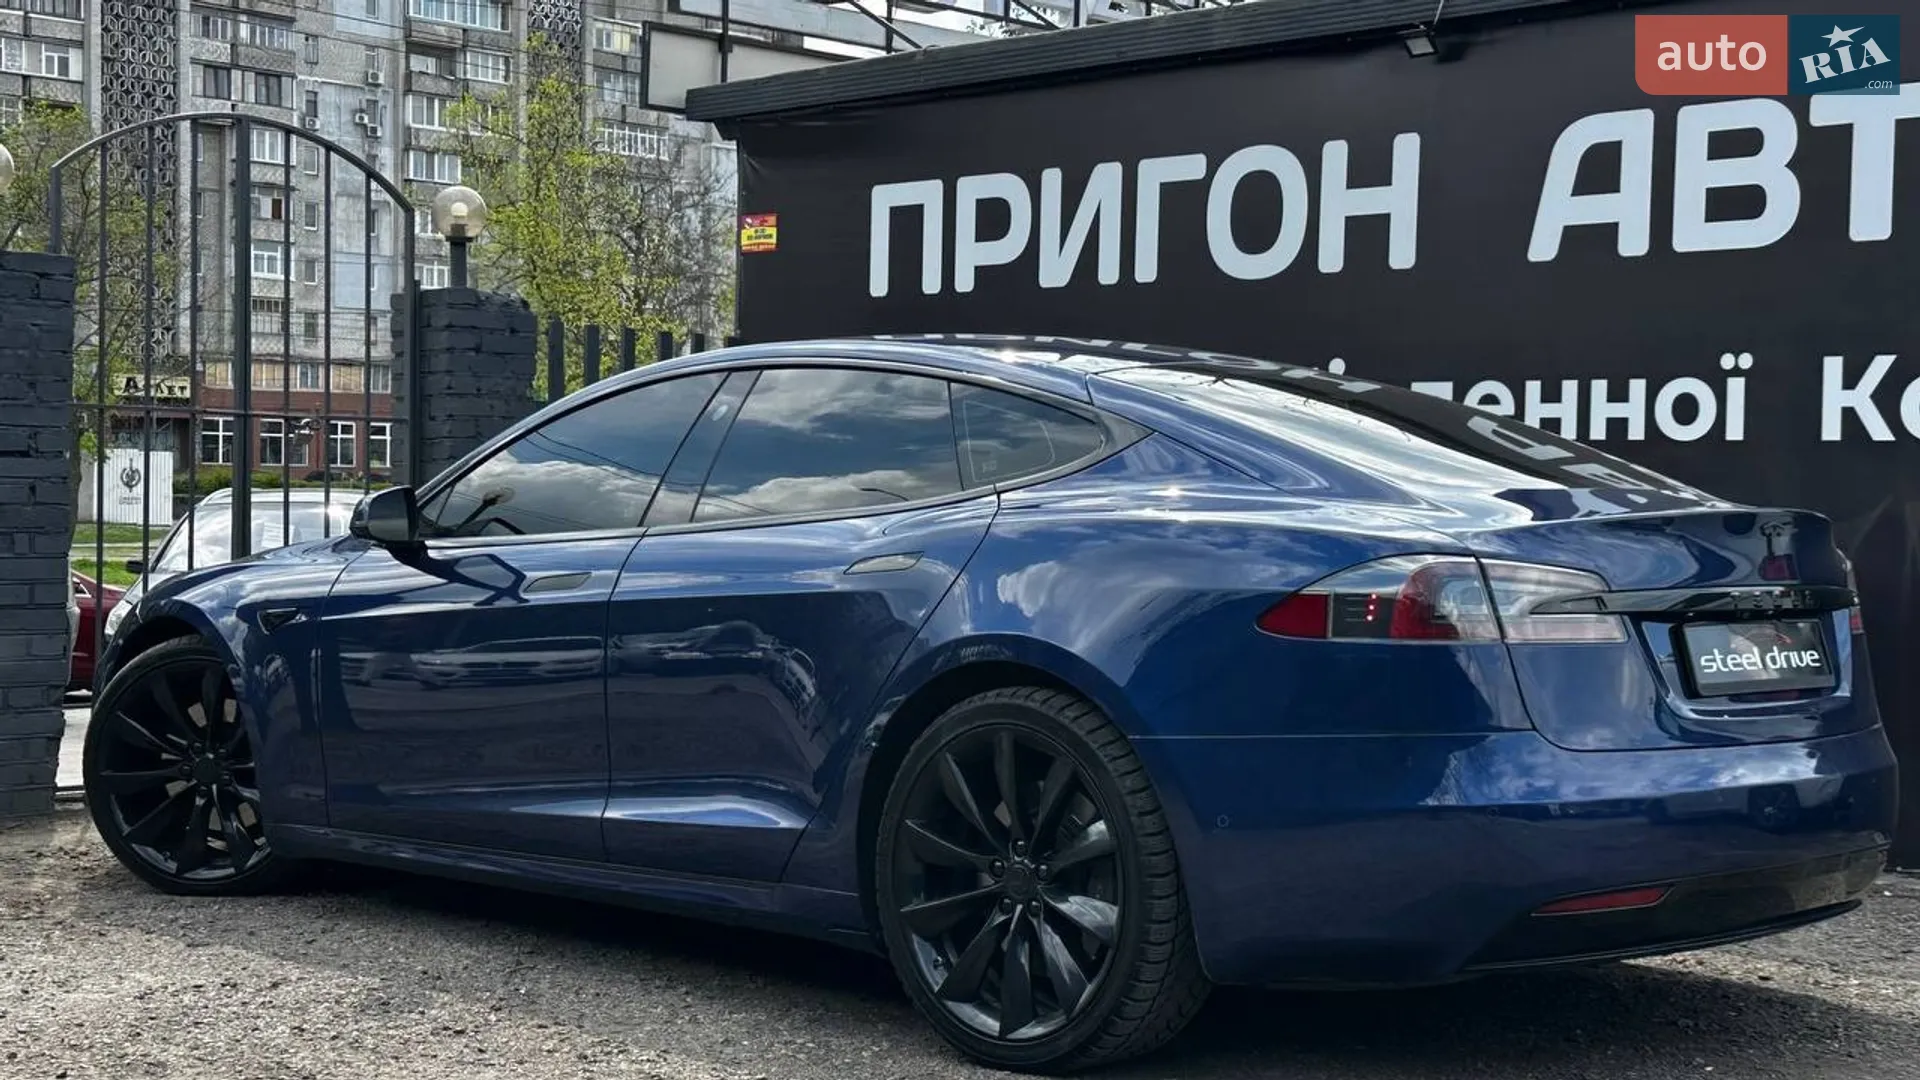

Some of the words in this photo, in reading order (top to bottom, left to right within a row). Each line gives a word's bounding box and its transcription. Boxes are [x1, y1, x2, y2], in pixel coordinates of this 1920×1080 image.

[870, 132, 1421, 298] ПРИГОН
[1700, 646, 1763, 673] steel
[1765, 645, 1821, 669] drive
